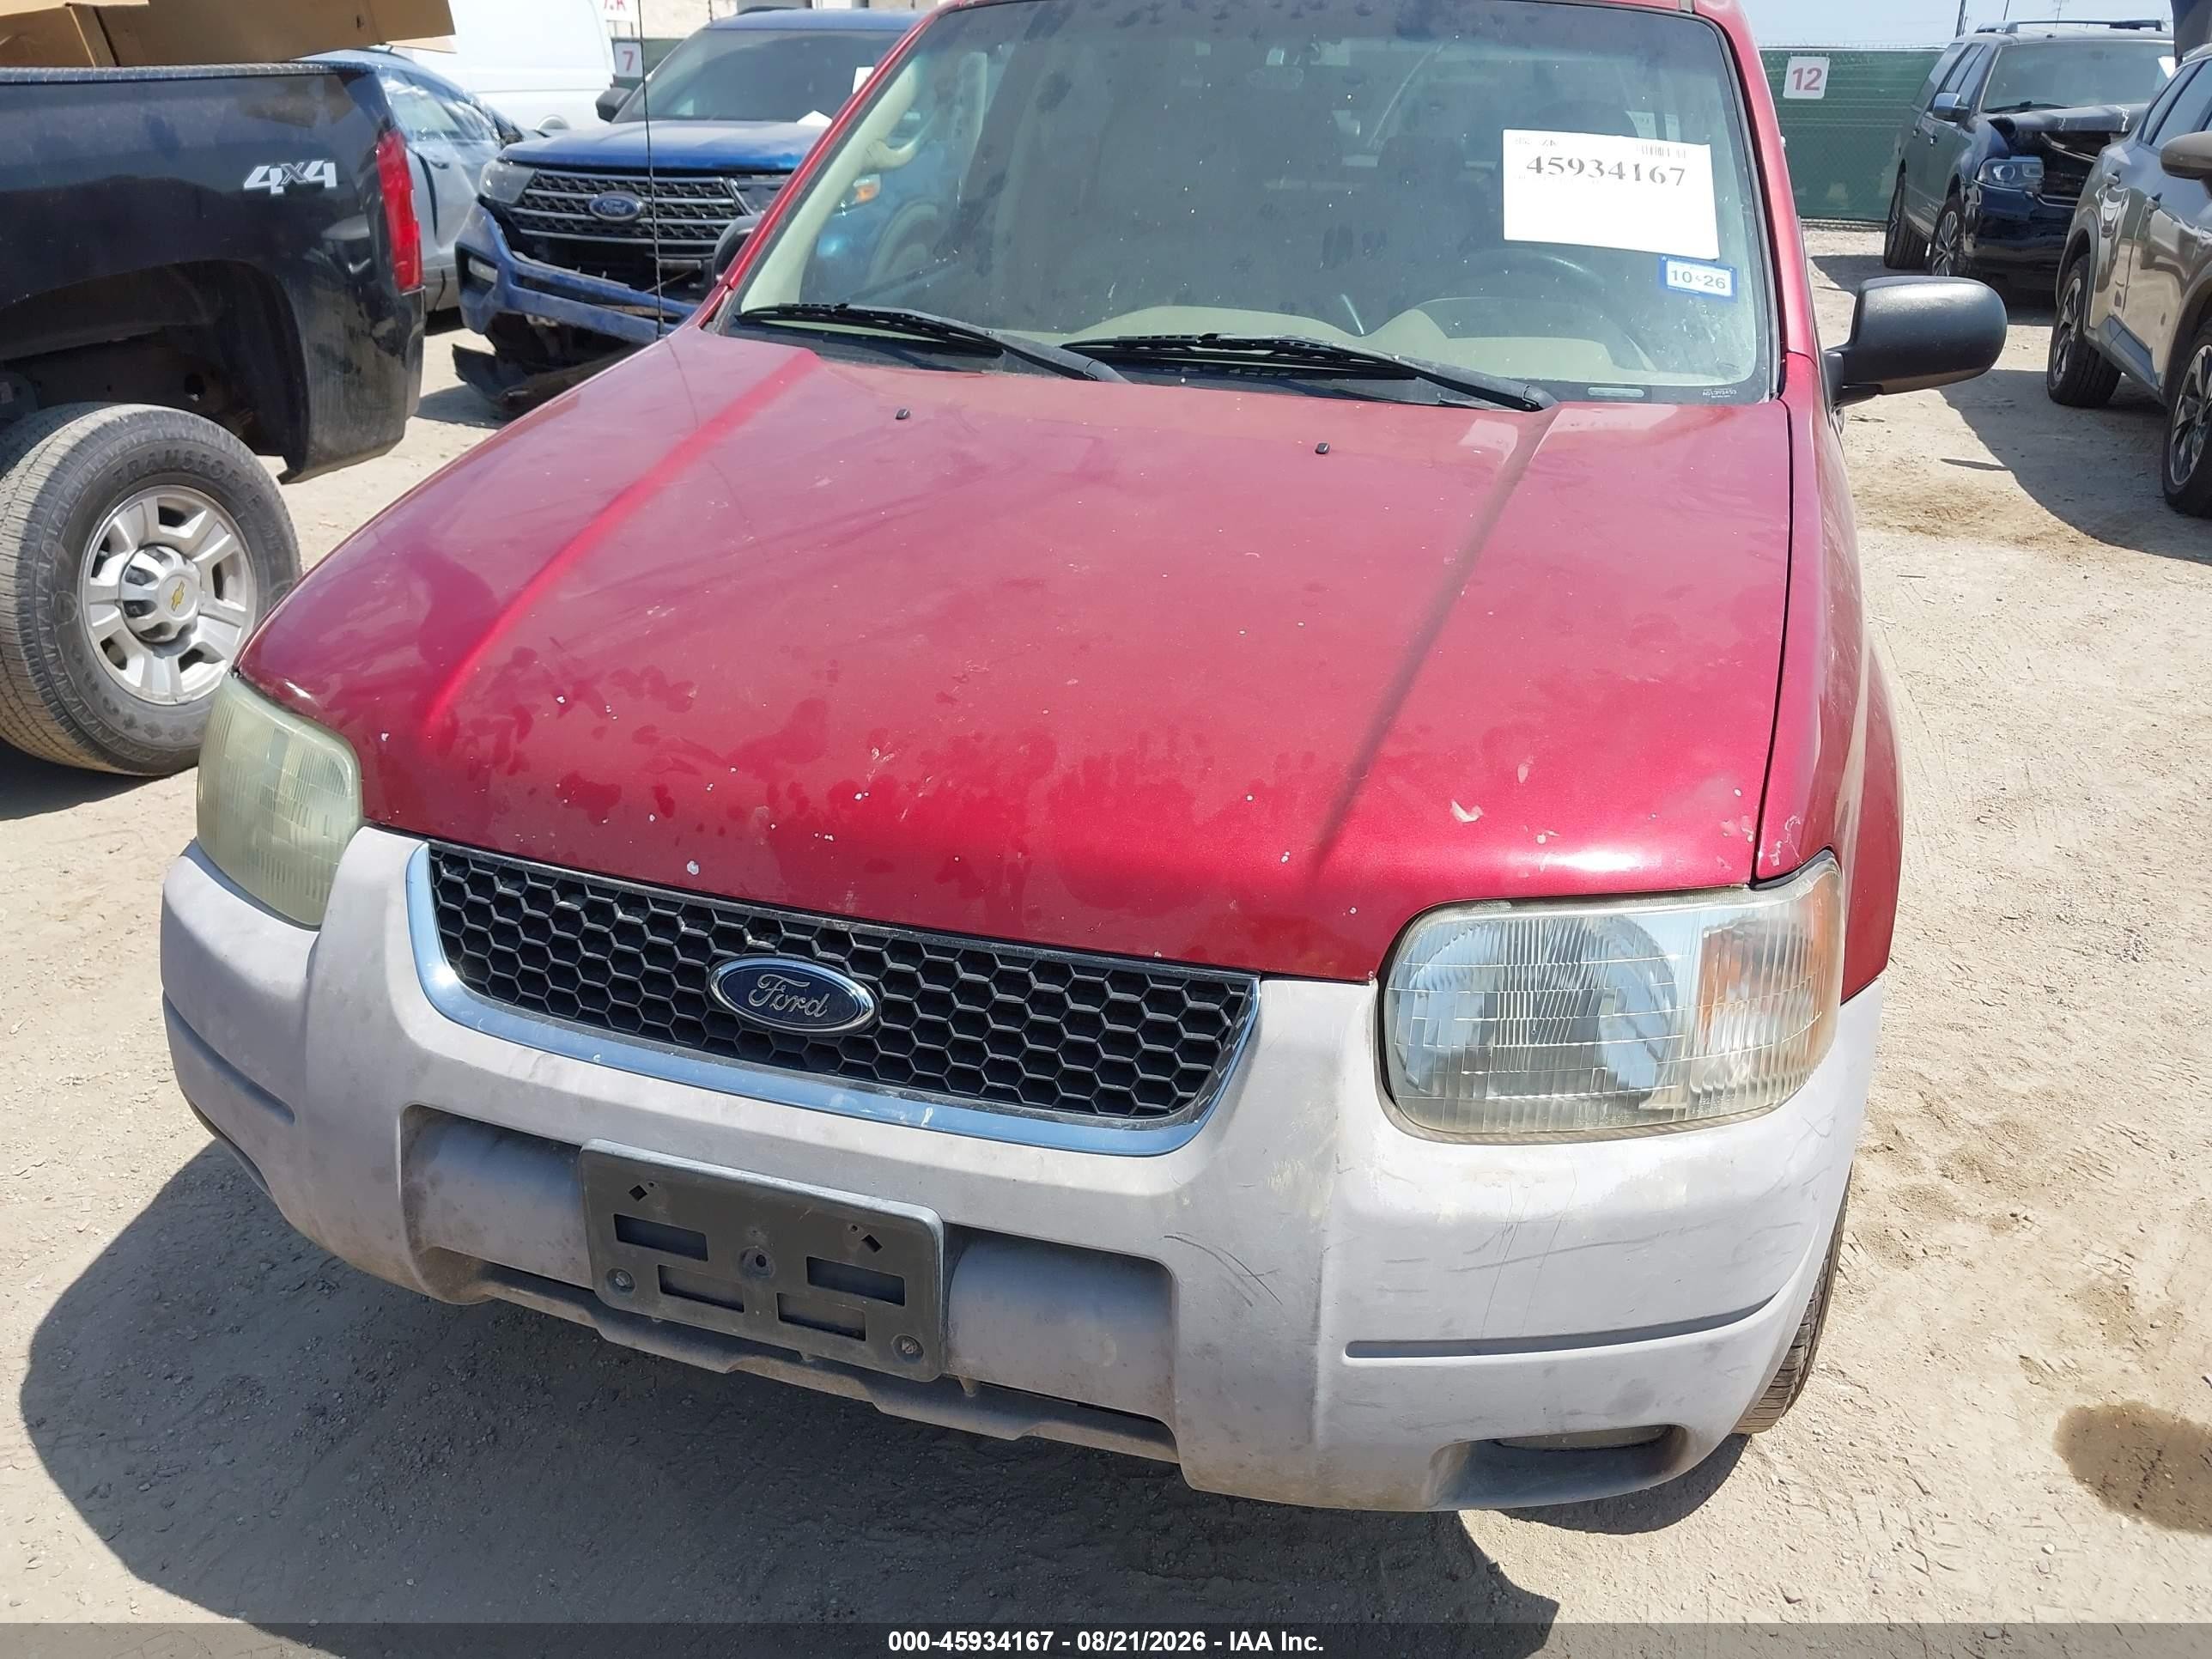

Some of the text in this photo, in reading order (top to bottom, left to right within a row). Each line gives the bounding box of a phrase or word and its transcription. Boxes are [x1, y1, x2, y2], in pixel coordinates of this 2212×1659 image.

[623, 51, 634, 71] 7
[1792, 67, 1823, 91] 12
[1526, 155, 1686, 186] 45934167
[1671, 270, 1726, 289] 10 26
[748, 973, 830, 1018] Ford
